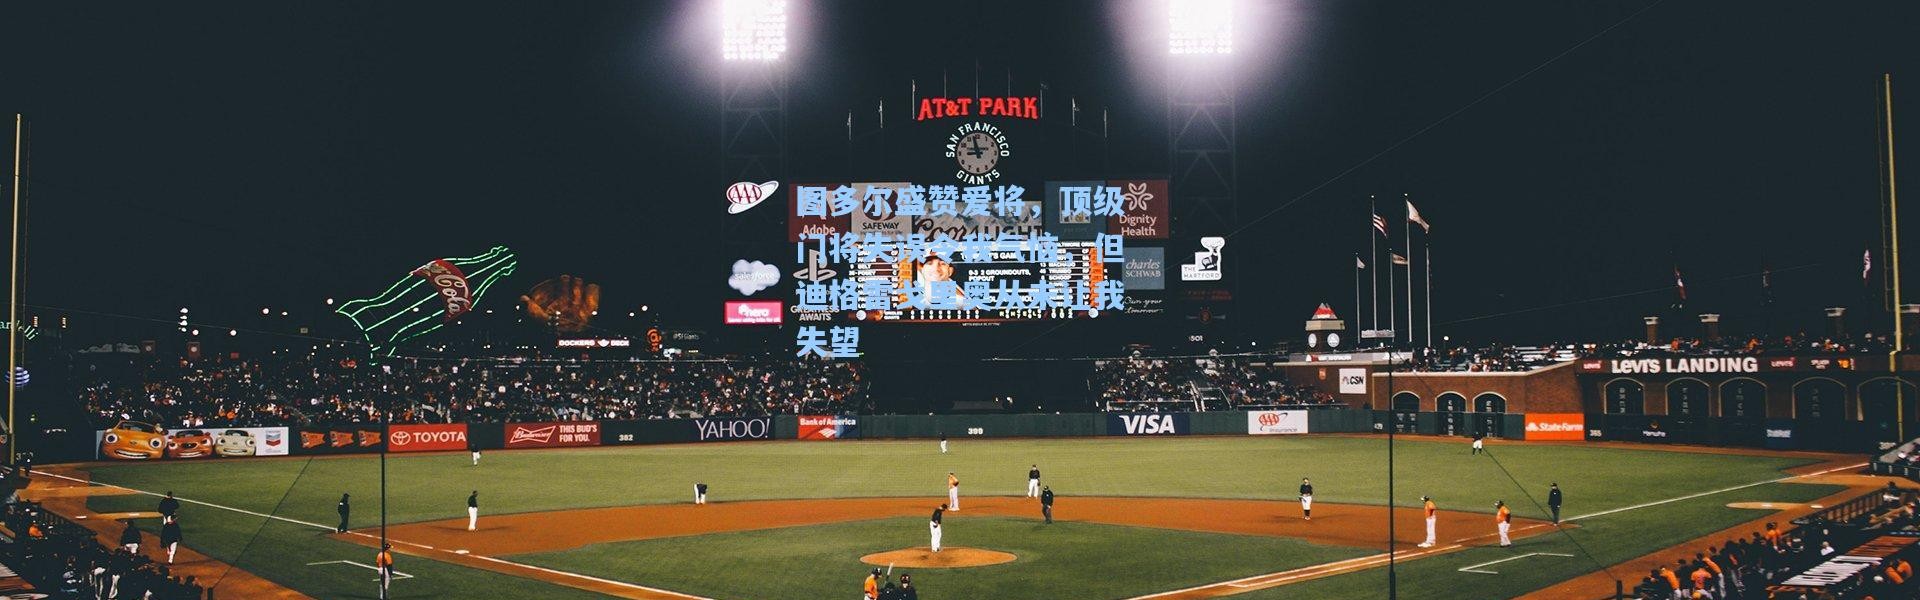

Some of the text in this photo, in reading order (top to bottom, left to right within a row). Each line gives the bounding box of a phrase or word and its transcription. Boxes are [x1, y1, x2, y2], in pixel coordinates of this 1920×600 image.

[917, 96, 1039, 121] AT&T PARK
[945, 121, 1010, 158] SAN FRANCISCO
[956, 169, 1001, 185] GIANTS
[1118, 214, 1158, 226] Dignity
[802, 224, 836, 236] Adobe
[862, 222, 899, 230] SAFEWAY
[1121, 227, 1156, 237] Health
[1125, 259, 1161, 269] charles
[1125, 269, 1161, 278] SCHWAB
[434, 274, 471, 315] Cola
[798, 313, 832, 321] AWAITS
[558, 339, 630, 347] DOCKERS DECK
[1665, 356, 1759, 373] LANDING
[1350, 375, 1364, 385] CSN
[799, 417, 819, 426] Bank
[826, 417, 857, 426] America
[1118, 414, 1176, 435] VISA
[559, 424, 598, 434] THIS BUD'S
[695, 417, 771, 441] YAHOO!
[412, 431, 467, 443] TOYOTA
[559, 433, 590, 443] FOR YOU.
